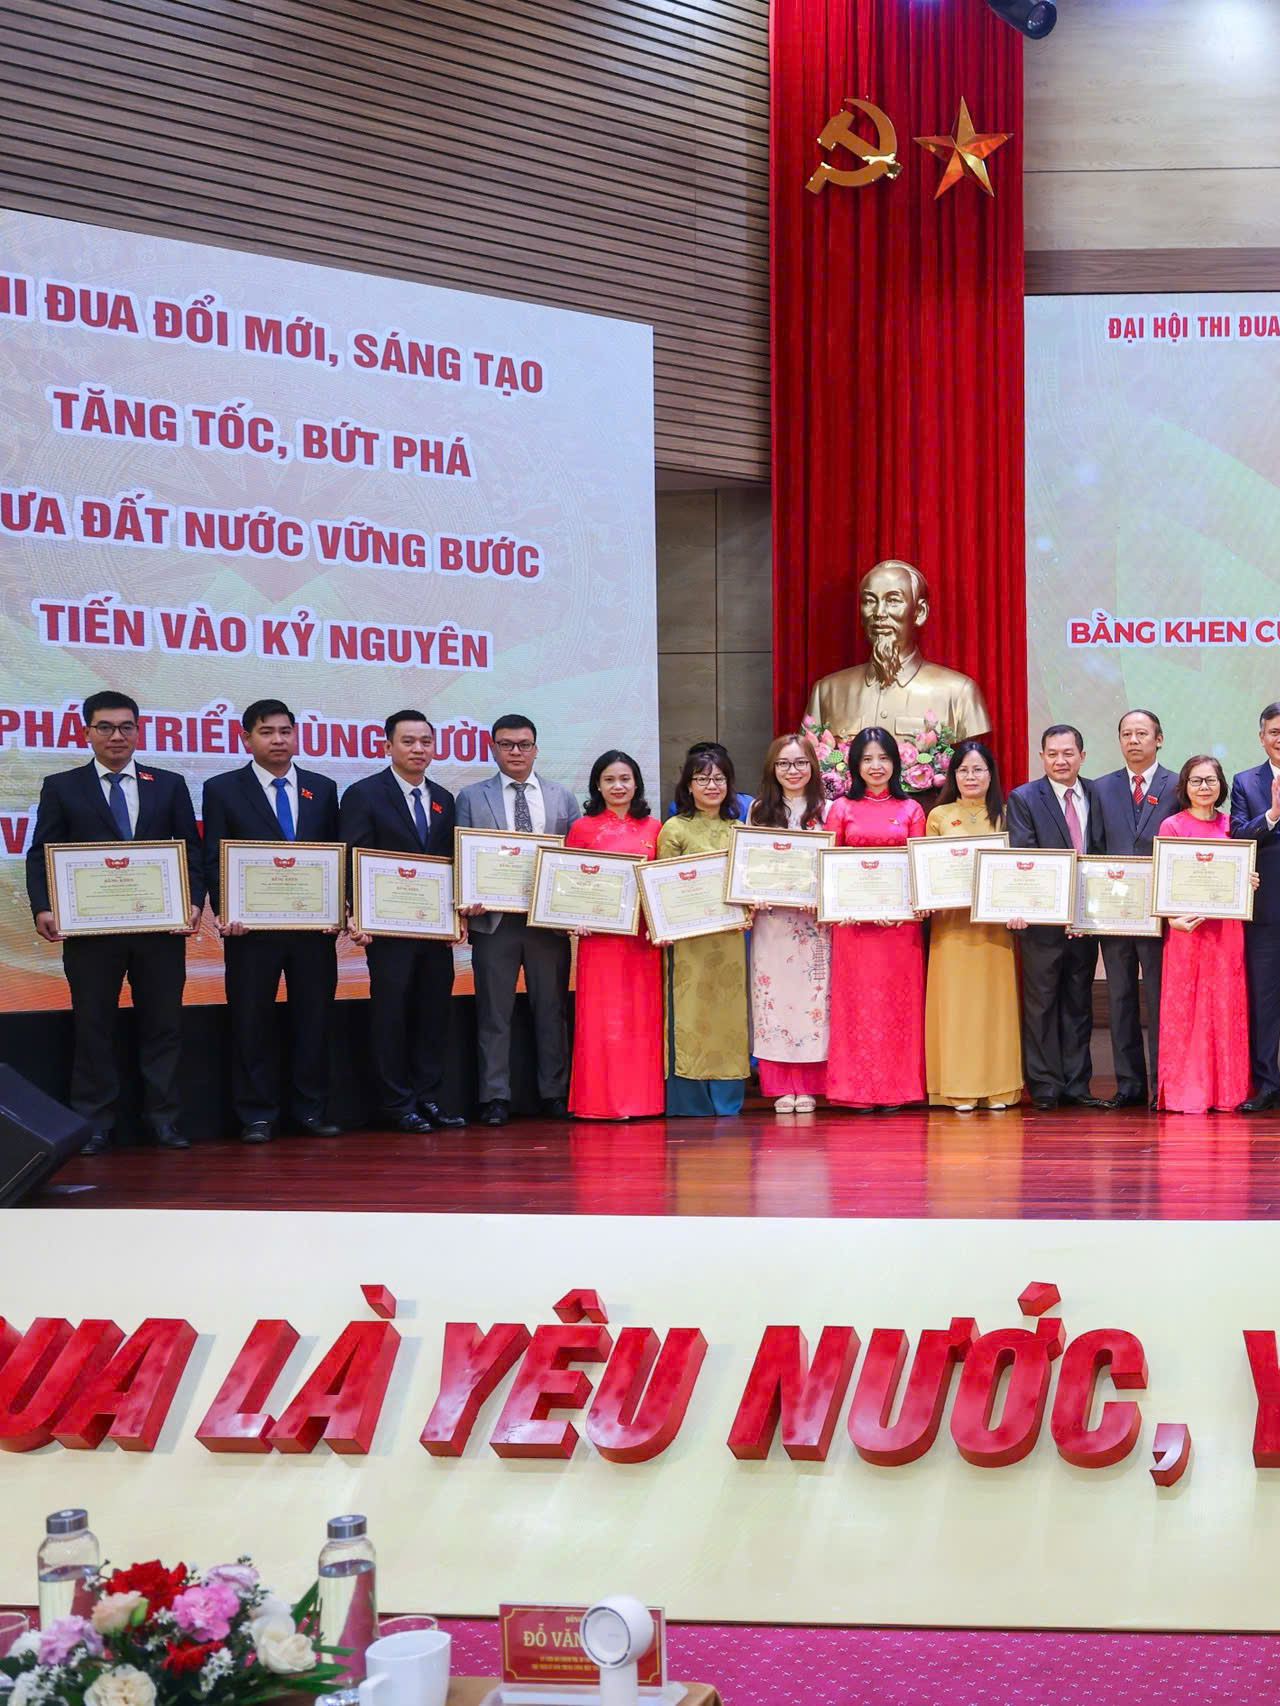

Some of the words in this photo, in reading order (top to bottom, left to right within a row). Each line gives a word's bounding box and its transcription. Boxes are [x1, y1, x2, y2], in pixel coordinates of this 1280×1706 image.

[44, 283, 139, 334] ĐUA
[153, 294, 228, 347] ĐỔI
[244, 316, 339, 367] MỚI,
[353, 331, 462, 382] SÁNG
[473, 352, 543, 397] TẠO
[1108, 316, 1145, 343] ĐẠI
[1153, 312, 1188, 343] HỘI
[1197, 316, 1230, 337] THI
[1238, 315, 1280, 337] ĐUA
[53, 387, 177, 442] TĂNG
[192, 402, 288, 459] TỐC,
[303, 422, 380, 466] BỨT
[393, 437, 472, 478] PHÁ
[81, 493, 169, 544] ĐẤT
[185, 511, 303, 557] NƯỚC
[317, 521, 426, 568] VỮNG
[440, 536, 540, 578] BƯỚC
[40, 596, 145, 647] TIẾN
[160, 607, 247, 652] VÀO
[262, 610, 315, 658] KỶ
[329, 625, 488, 668] NGUYÊN
[1071, 612, 1156, 644] BẰNG
[1165, 621, 1247, 643] KHEN
[0, 704, 88, 748] PHÁ
[293, 715, 386, 759] ÙNG
[0, 1316, 199, 1452] UA
[195, 1284, 401, 1454] LÀ
[419, 1288, 709, 1464] YÊU
[726, 1281, 1192, 1487] NƯỚC,
